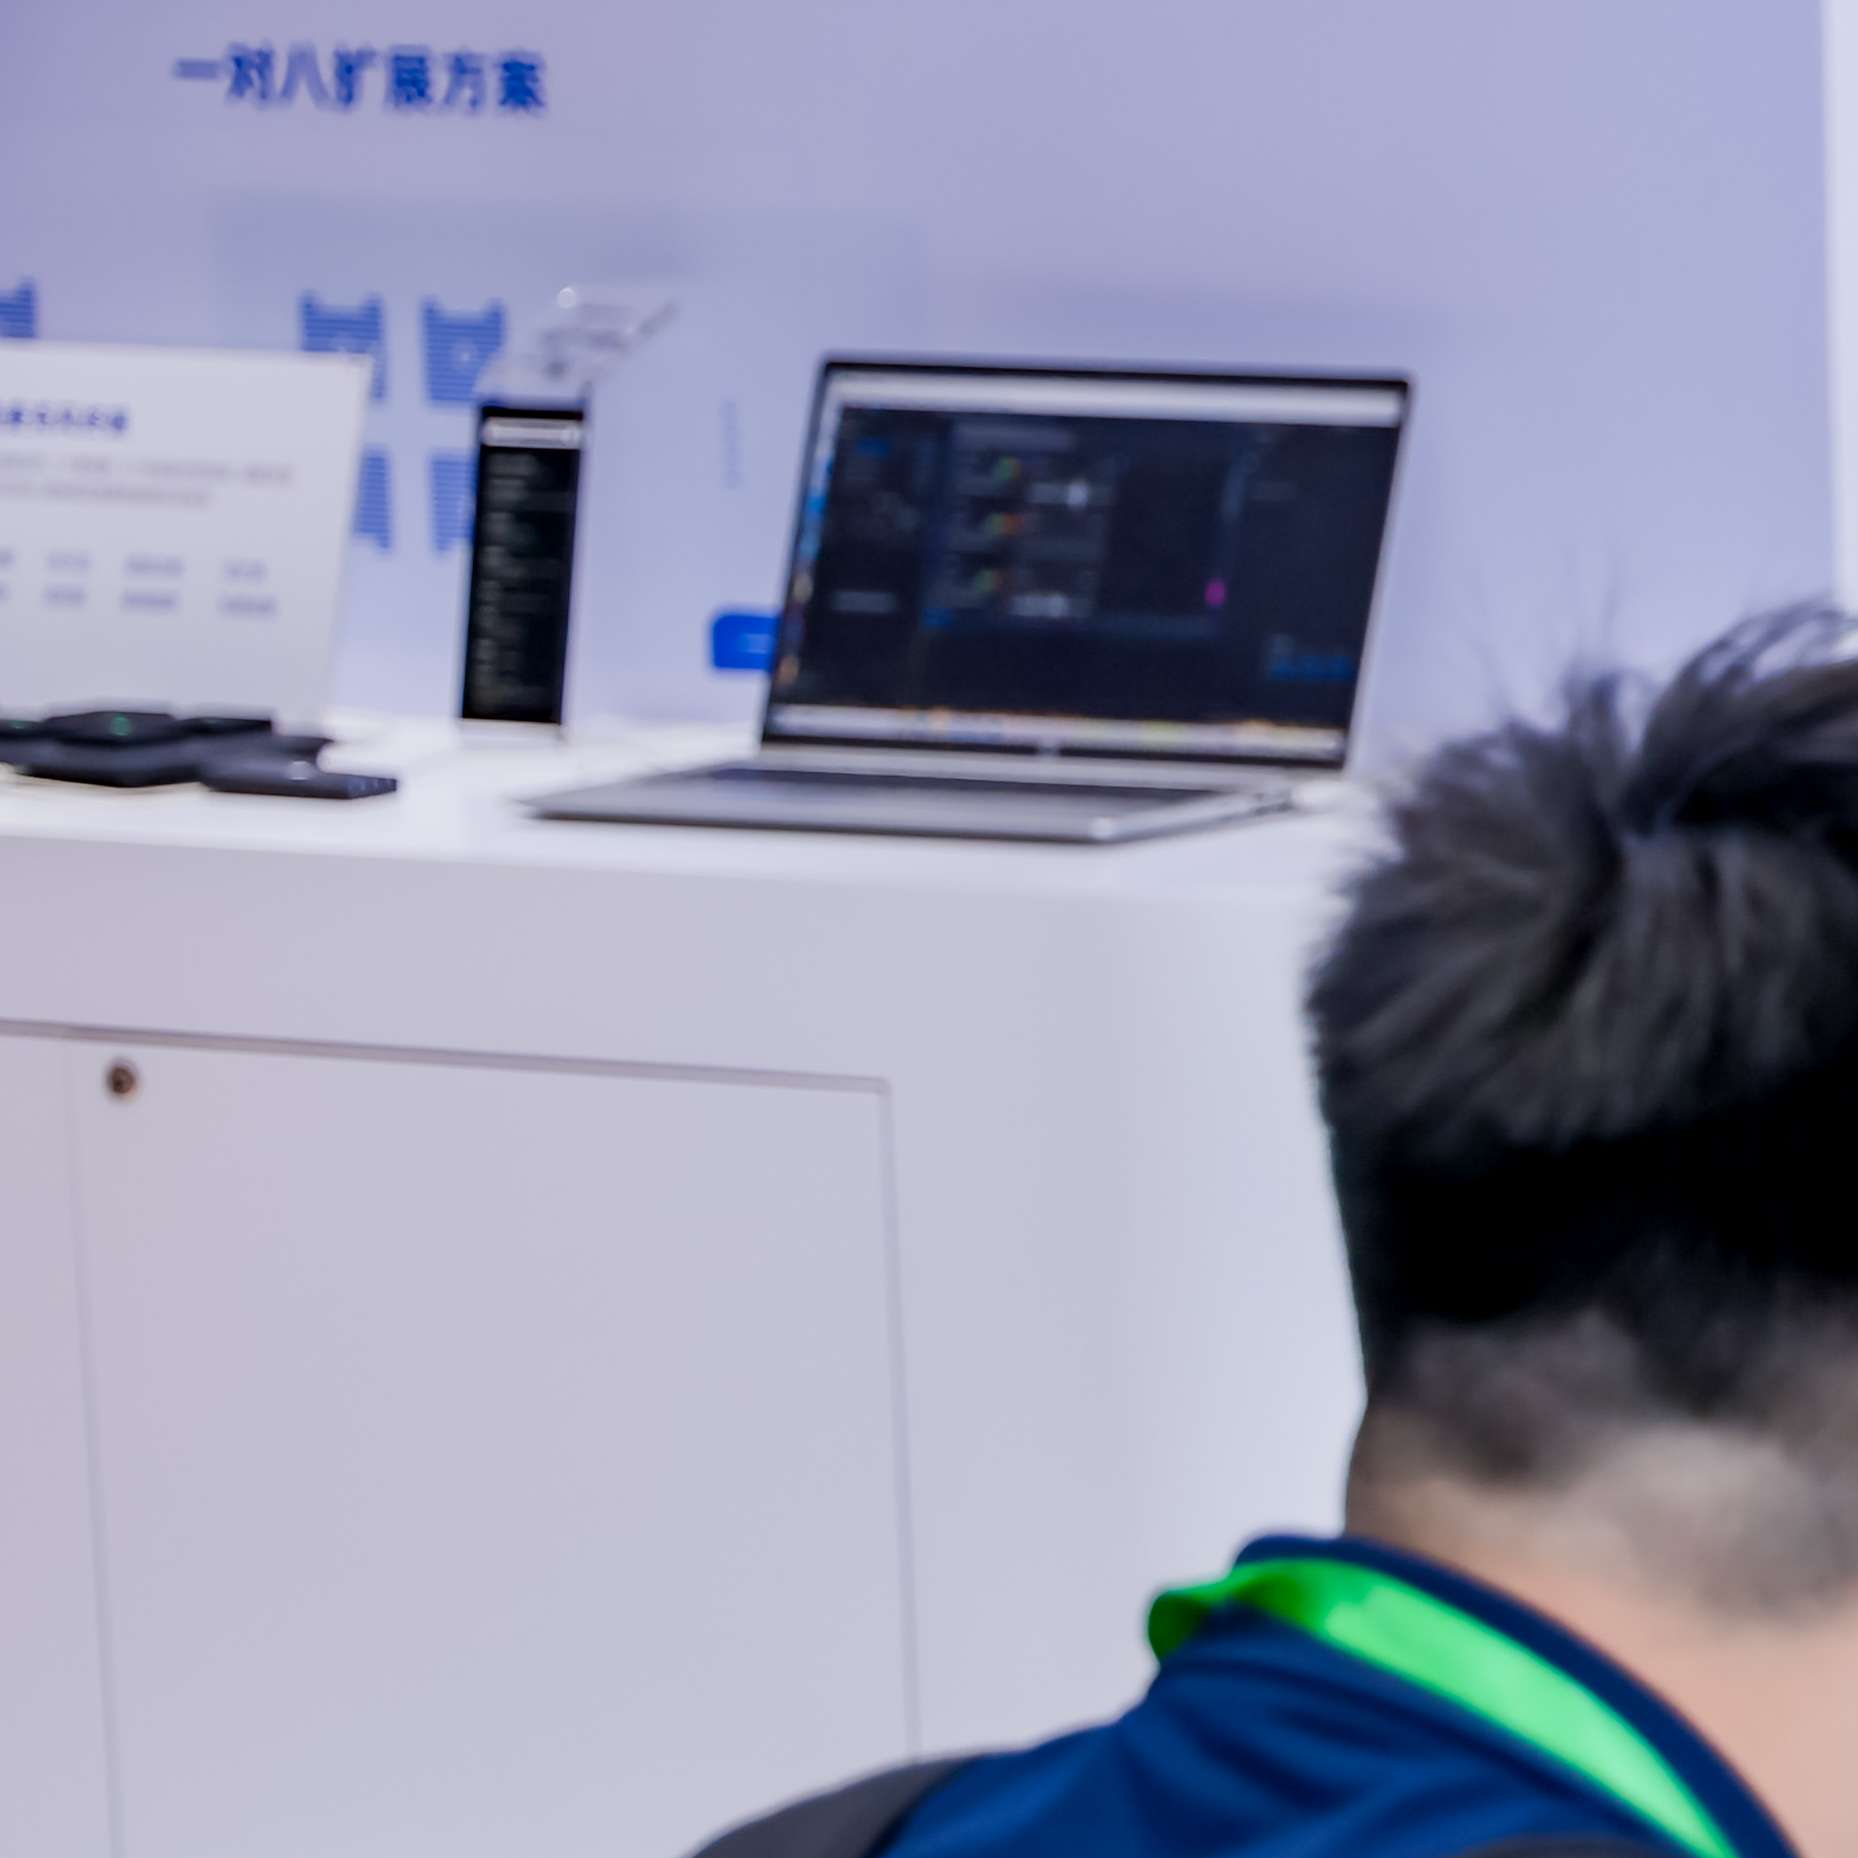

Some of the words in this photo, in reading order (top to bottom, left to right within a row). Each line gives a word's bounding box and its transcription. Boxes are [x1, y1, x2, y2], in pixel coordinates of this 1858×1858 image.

[175, 43, 548, 113] 一对八扩展方案
